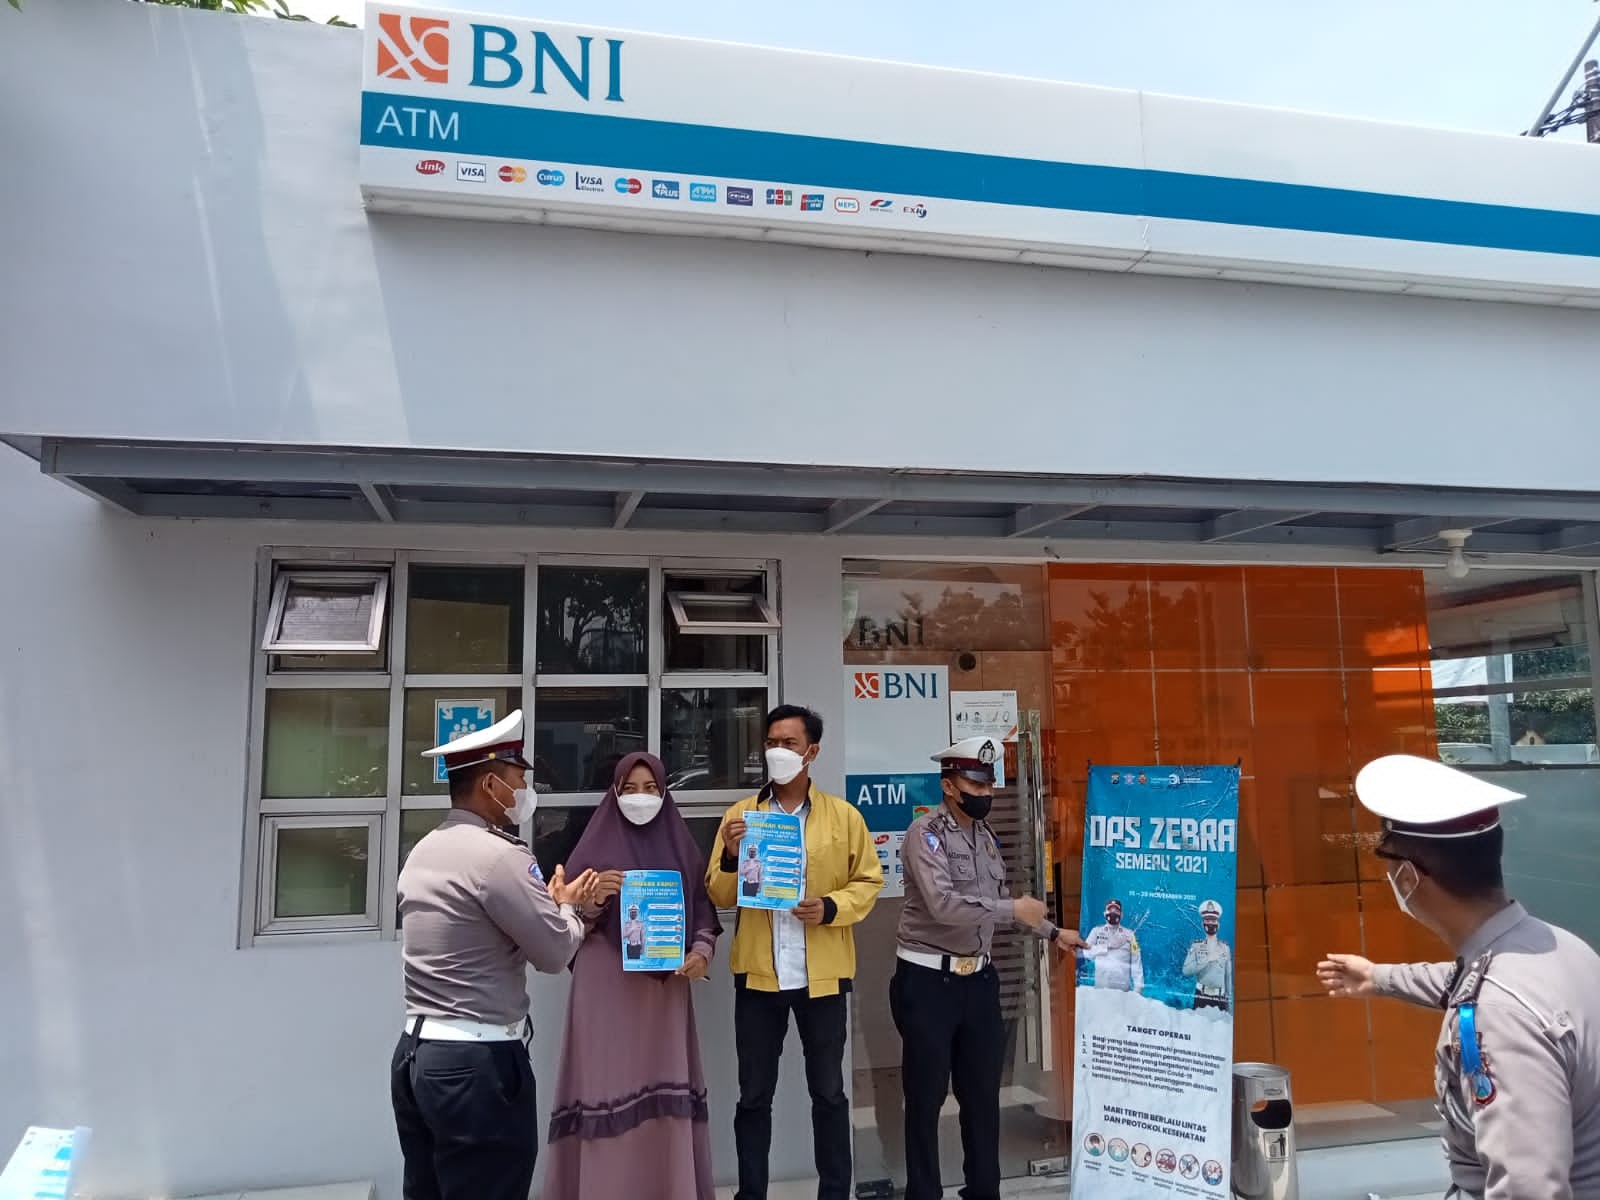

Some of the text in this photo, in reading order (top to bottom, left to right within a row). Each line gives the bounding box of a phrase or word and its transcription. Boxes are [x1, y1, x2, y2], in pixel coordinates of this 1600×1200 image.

[468, 23, 625, 101] BNI
[376, 105, 460, 141] ATM
[418, 161, 442, 172] Link
[461, 167, 485, 178] VISA
[580, 175, 603, 186] VISA
[884, 672, 938, 699] BNI
[857, 783, 906, 806] ATM
[1090, 815, 1236, 853] OPS ZEBRA
[1115, 852, 1208, 874] SEMERU 2021
[1127, 1025, 1191, 1041] TARGET OPERASI
[1103, 1104, 1207, 1133] MARI TERTIB BERLALU LINTAS
[1104, 1114, 1206, 1143] DAN PROTOKOL KESEHATAN
